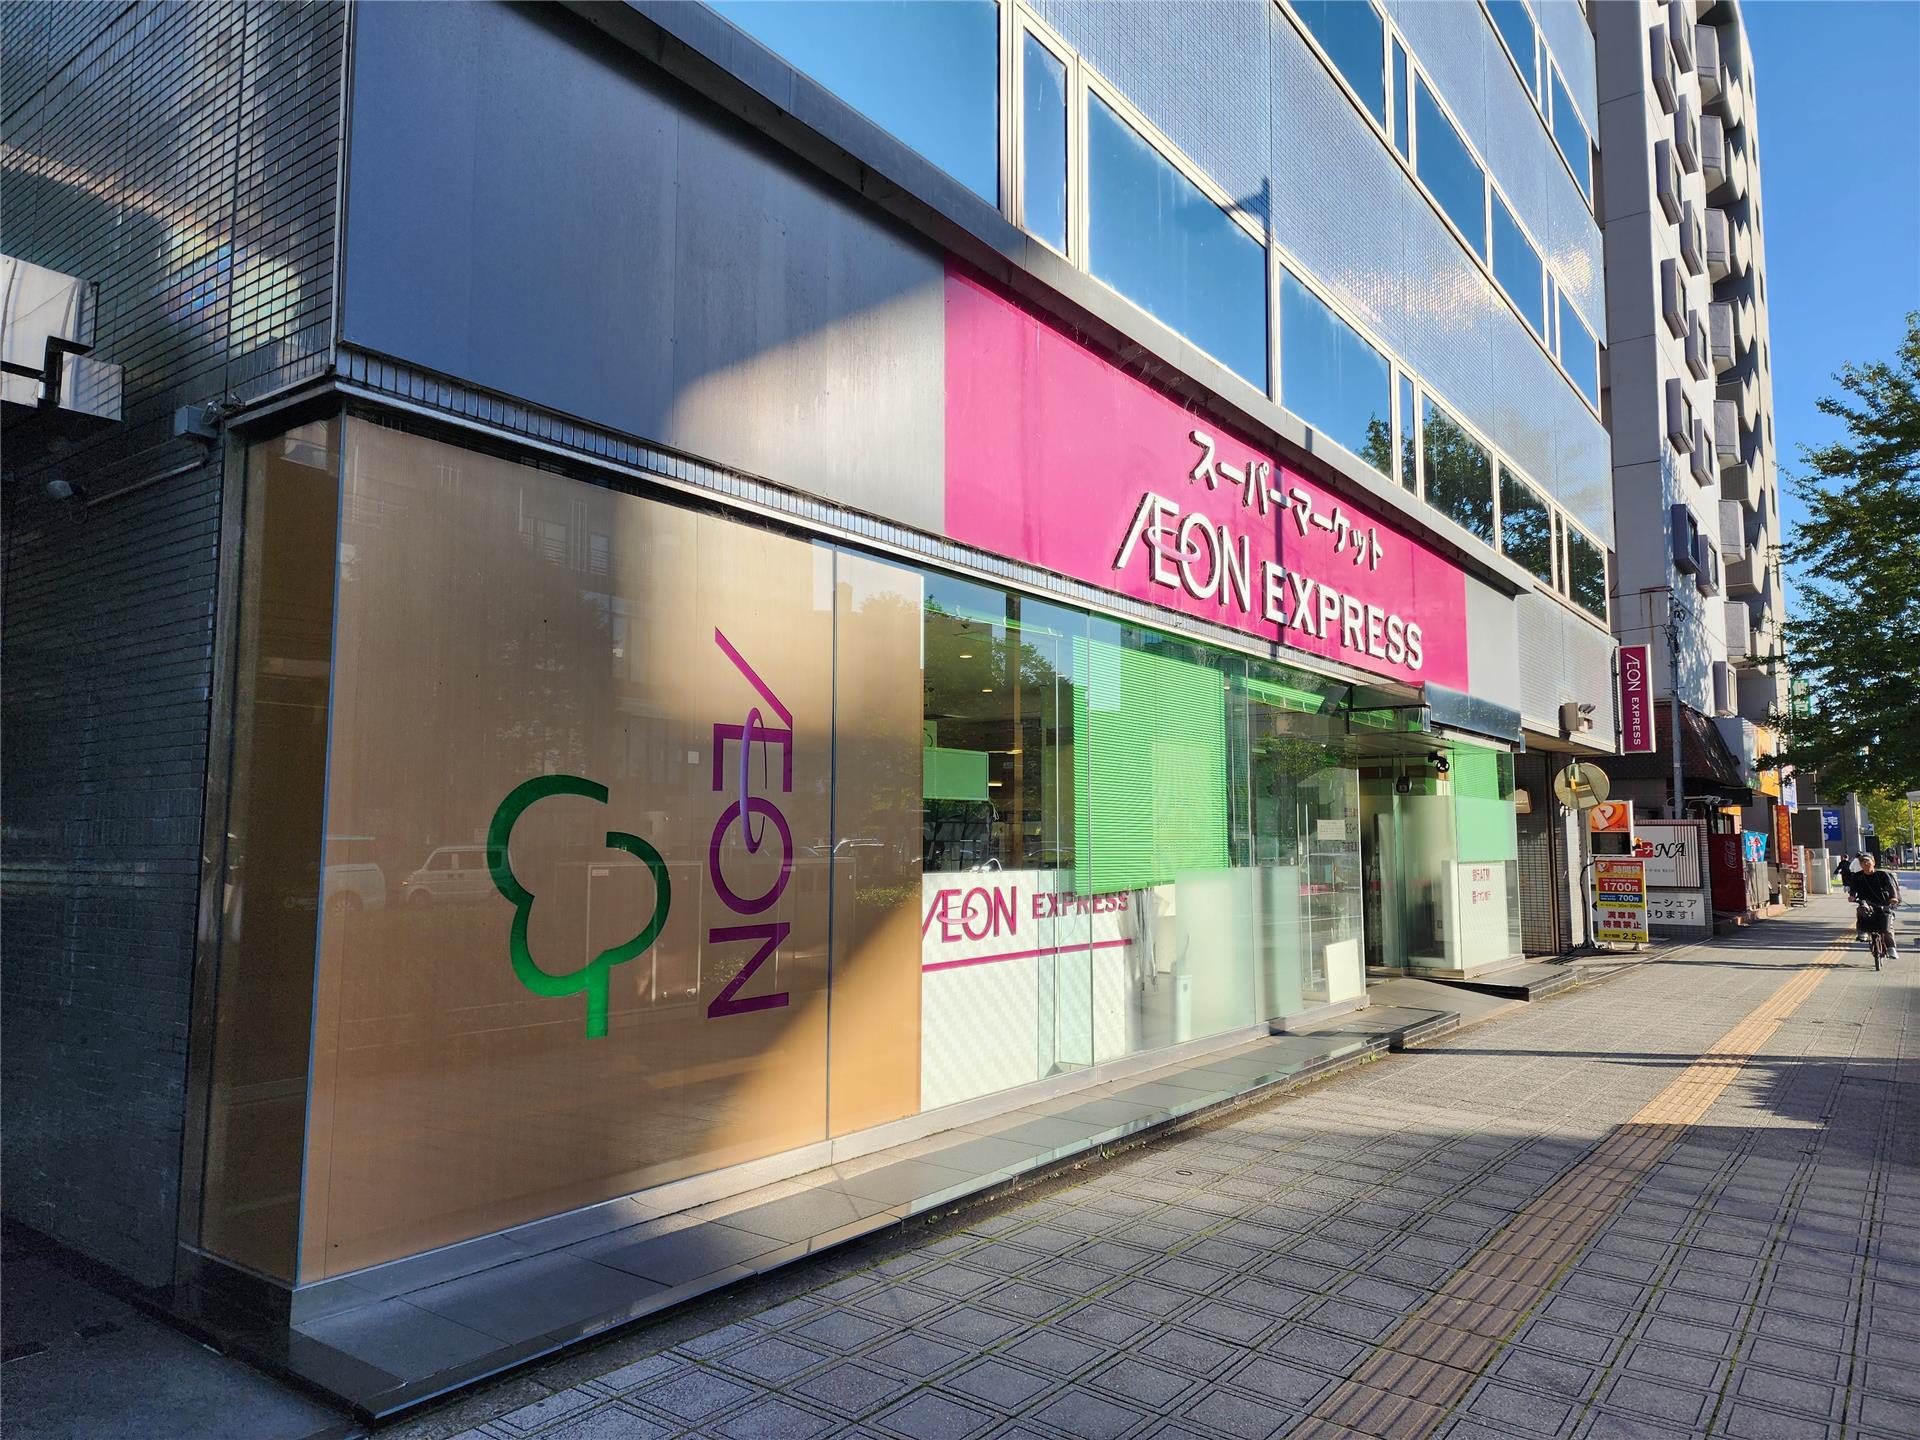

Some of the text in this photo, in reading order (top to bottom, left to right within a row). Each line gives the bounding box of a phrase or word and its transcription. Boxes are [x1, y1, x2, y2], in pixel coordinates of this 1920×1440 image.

[1189, 430, 1383, 571] スーパーマーケット
[1260, 560, 1424, 671] EXPRESS
[1631, 697, 1641, 745] EXPRESS
[1603, 882, 1639, 892] 1700円
[1617, 894, 1640, 902] 700円
[1031, 890, 1130, 920] EXPRESS
[1647, 898, 1697, 908] ーシェア
